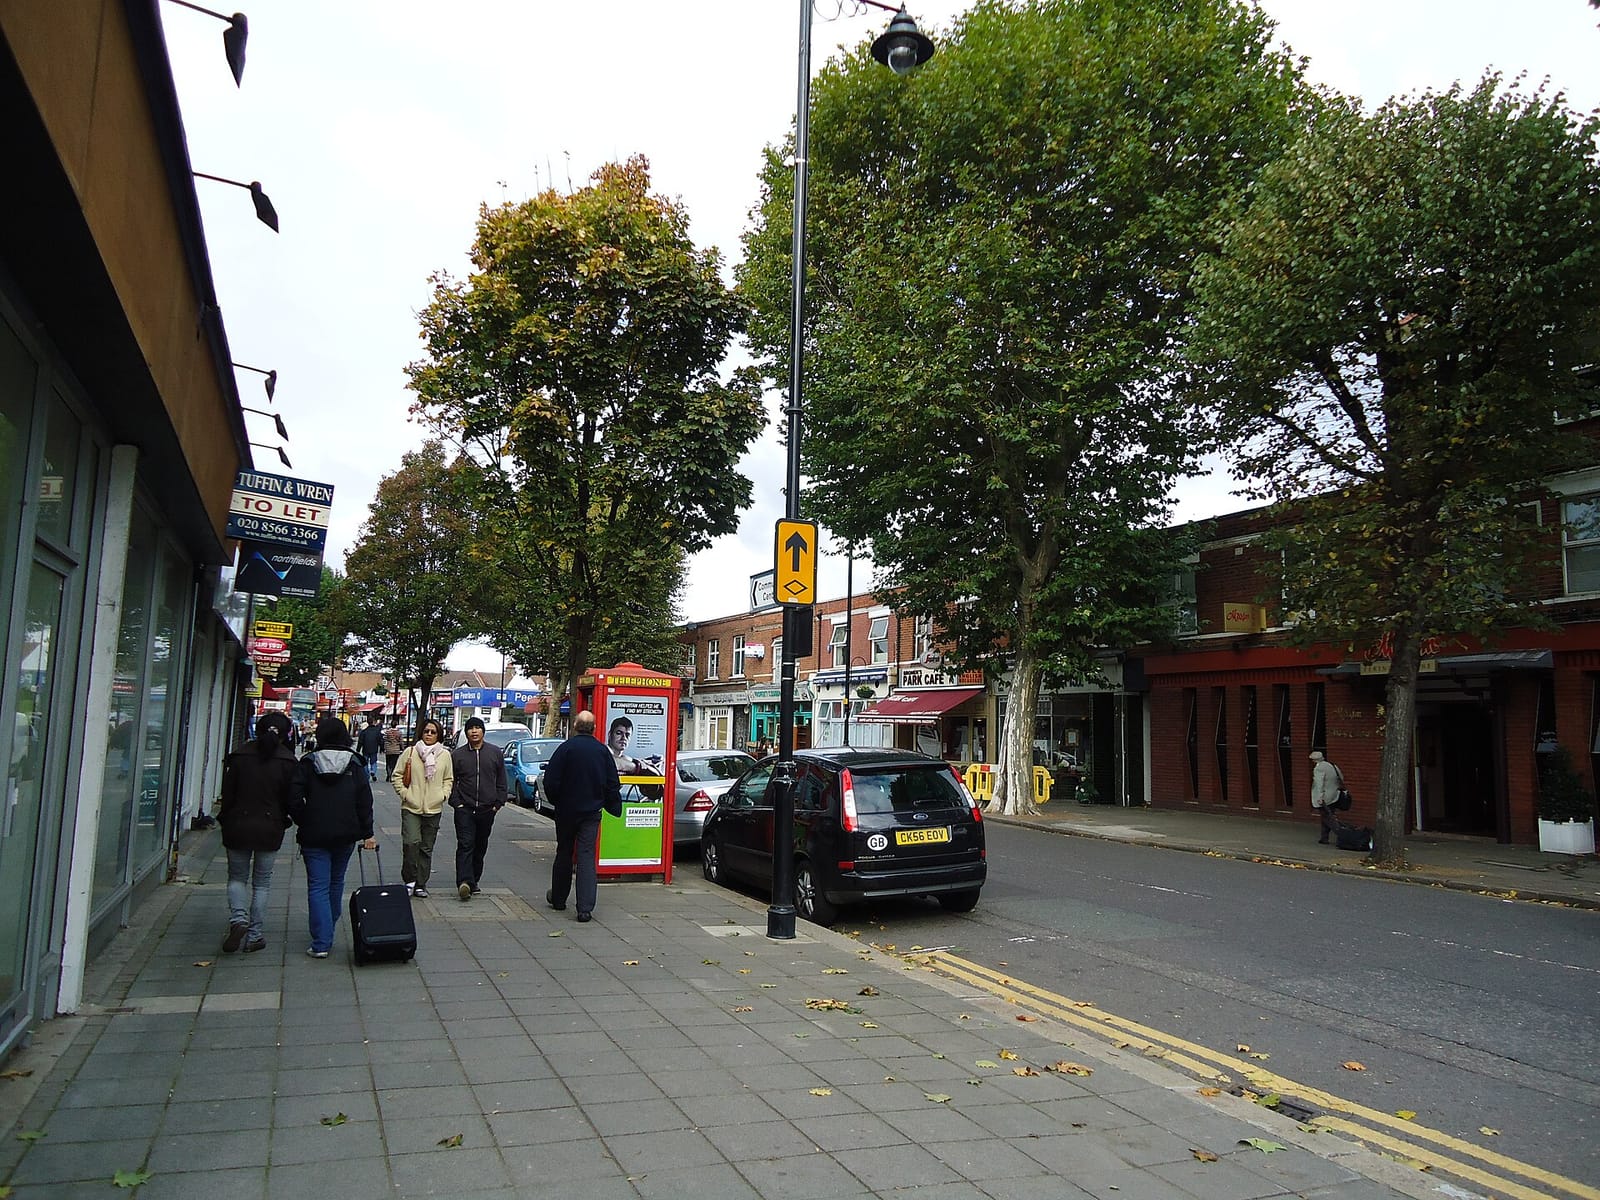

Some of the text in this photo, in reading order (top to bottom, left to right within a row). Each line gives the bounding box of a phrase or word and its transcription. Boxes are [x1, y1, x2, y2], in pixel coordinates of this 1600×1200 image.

[239, 472, 331, 501] TUFFIN & WREN
[241, 497, 321, 521] TO LET
[237, 517, 318, 540] 020 8566 3366
[271, 555, 318, 567] northfields
[613, 677, 667, 687] TELEPHONE
[903, 674, 945, 686] PARK CAFE
[869, 837, 885, 848] GB
[900, 830, 944, 843] CK56 EOV
